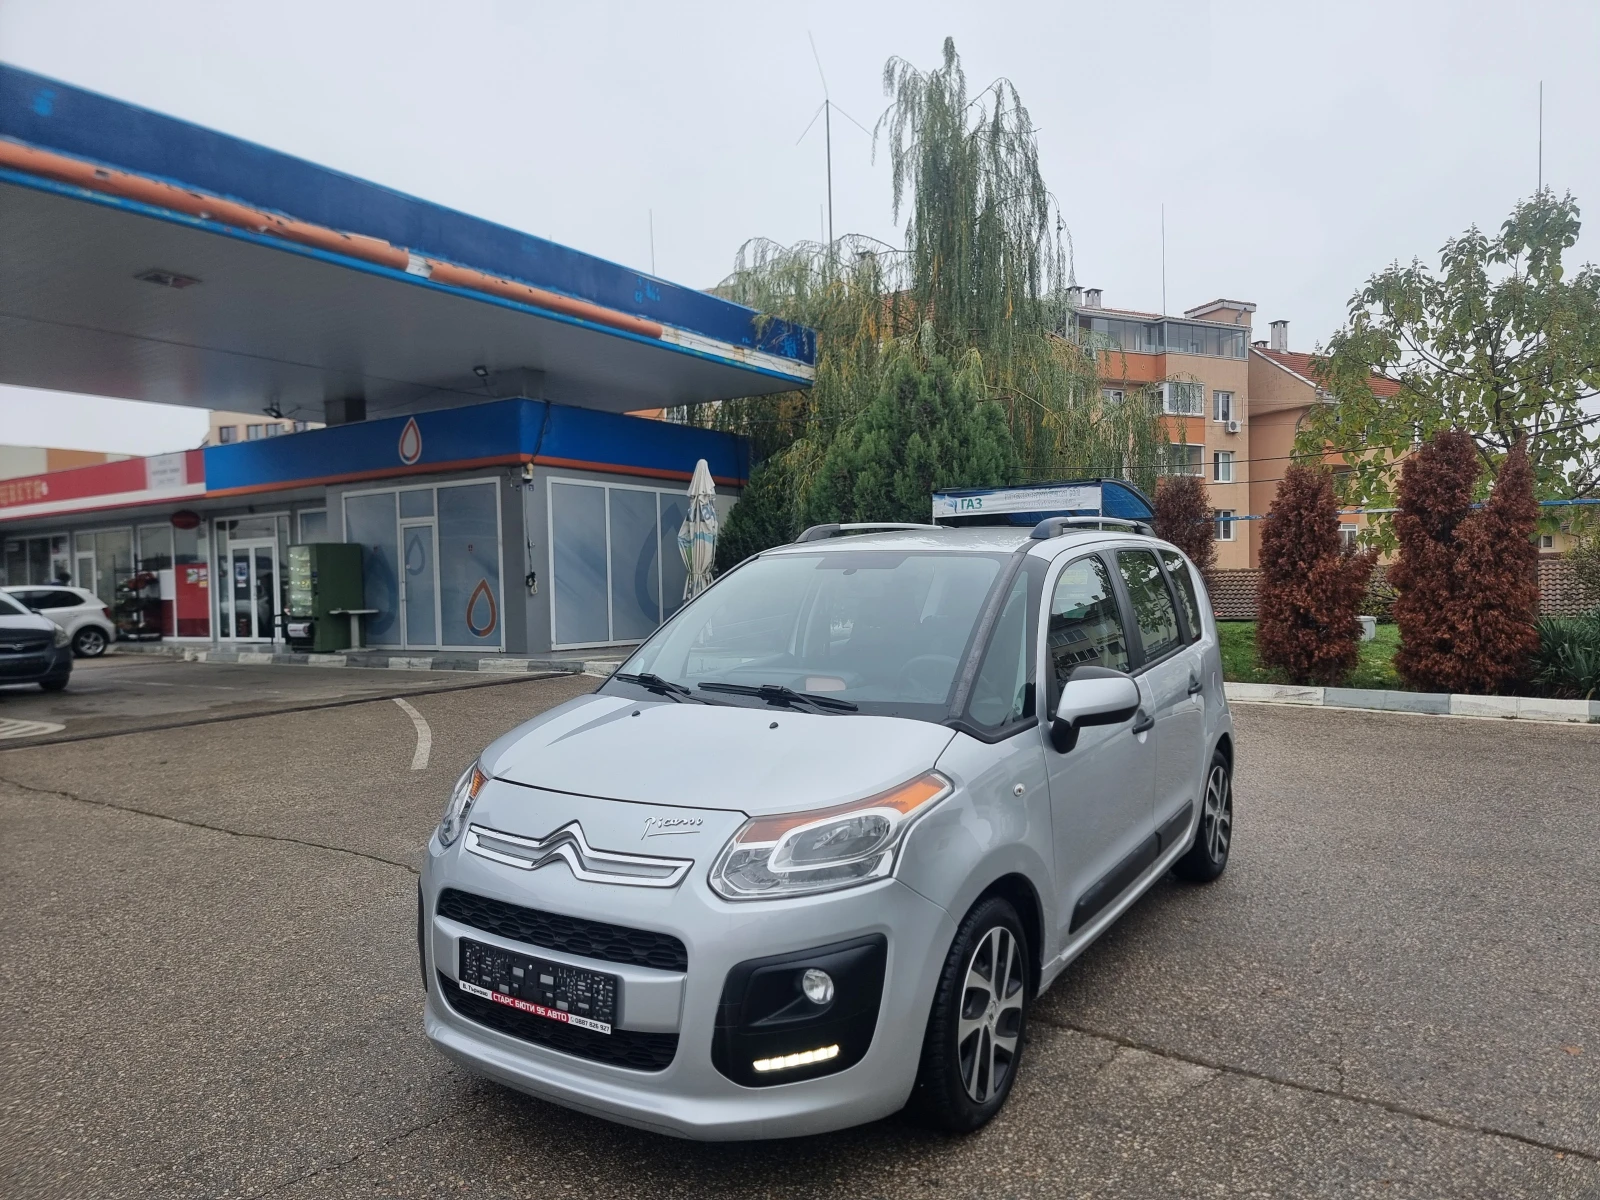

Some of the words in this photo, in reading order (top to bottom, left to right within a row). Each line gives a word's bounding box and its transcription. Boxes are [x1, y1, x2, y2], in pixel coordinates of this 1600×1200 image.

[961, 498, 982, 510] ГАЗ
[493, 993, 514, 1006] СТАРС
[515, 999, 535, 1012] БЮТИ
[536, 1006, 546, 1015] 95
[547, 1010, 567, 1022] АВТО
